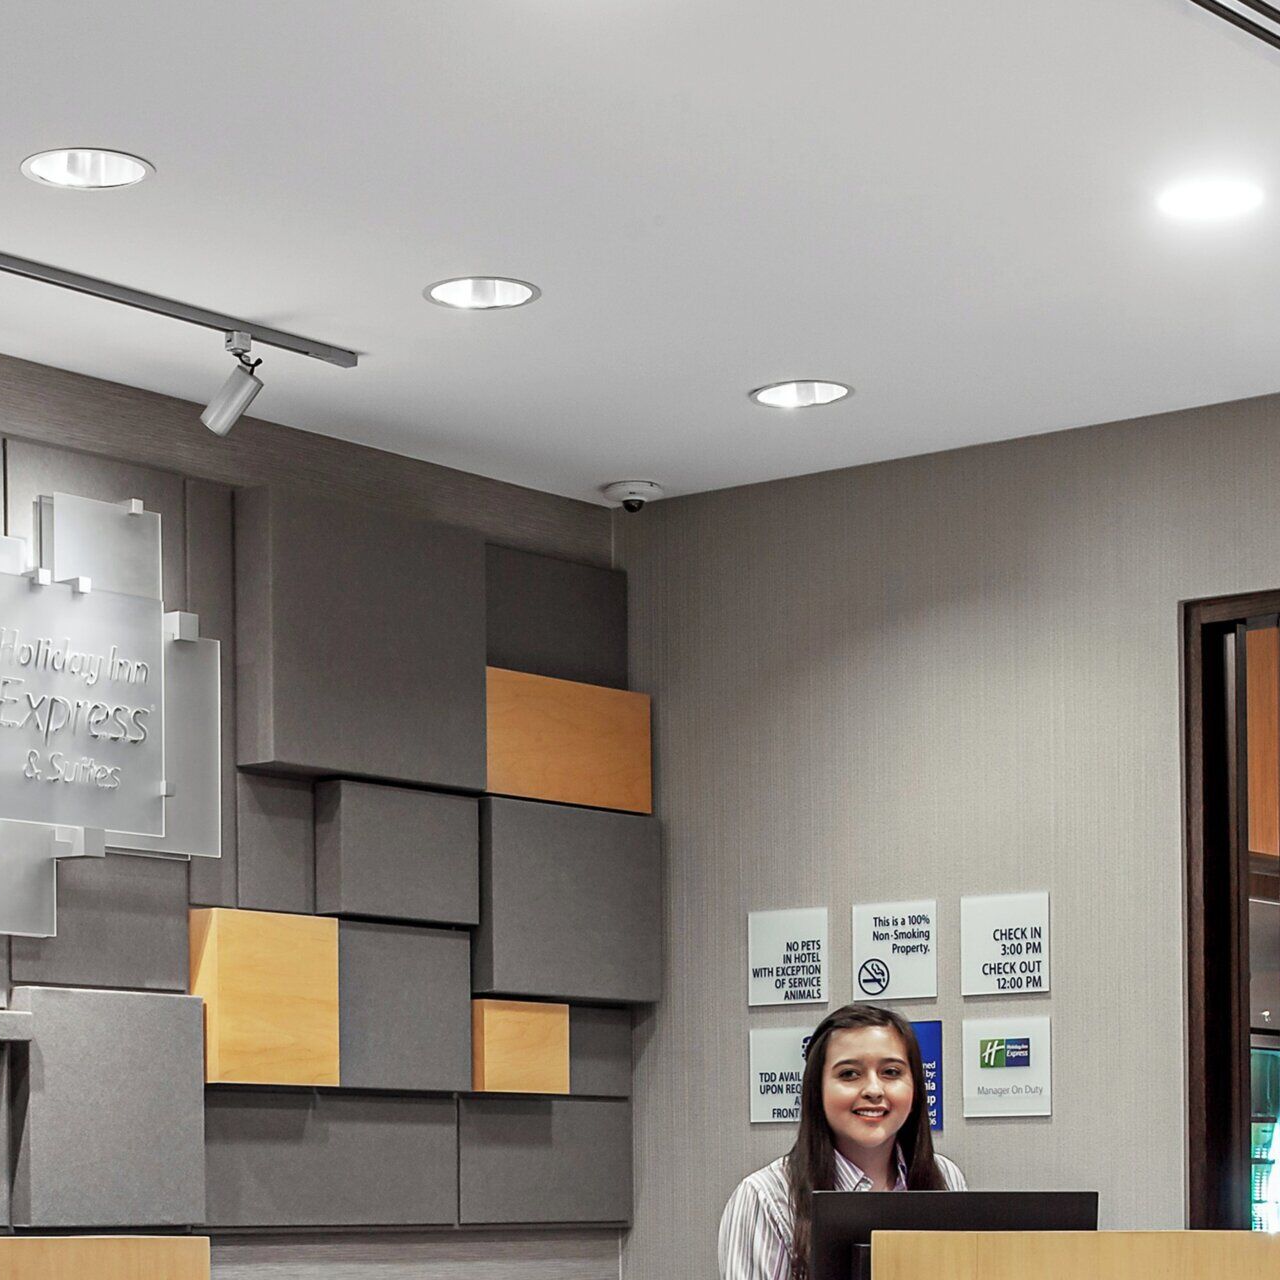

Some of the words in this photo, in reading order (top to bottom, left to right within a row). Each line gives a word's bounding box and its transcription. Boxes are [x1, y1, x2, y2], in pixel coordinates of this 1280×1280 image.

[107, 644, 150, 684] Inn
[23, 749, 42, 780] &
[46, 752, 121, 789] Suites
[873, 916, 890, 927] This
[892, 916, 898, 926] is
[900, 917, 906, 926] a
[908, 914, 931, 925] 100%
[993, 927, 1027, 941] CHECK
[1030, 926, 1042, 939] IN
[786, 942, 799, 952] NO
[801, 940, 821, 951] PETS
[892, 943, 930, 955] Property.
[1001, 943, 1022, 956] 3:00
[1026, 941, 1042, 954] PM
[783, 954, 792, 964] IN
[794, 952, 821, 963] HOTEL
[752, 967, 773, 978] WITH
[776, 965, 821, 977] EXCEPTION
[982, 962, 1016, 976] CHECK
[1019, 960, 1042, 973] OUT
[775, 979, 786, 989] OF
[788, 977, 821, 988] SERVICE
[996, 977, 1022, 989] 12:00
[1026, 975, 1042, 988] PM
[784, 989, 821, 1000] ANIMALS
[759, 1072, 776, 1082] TDD
[779, 1072, 802, 1082] AVAIL
[760, 1085, 783, 1094] UPON
[786, 1083, 802, 1094] REQ
[978, 1086, 1010, 1097] Manager
[1011, 1085, 1023, 1094] On
[1024, 1085, 1043, 1095] Duty
[772, 1108, 800, 1118] FRONT
